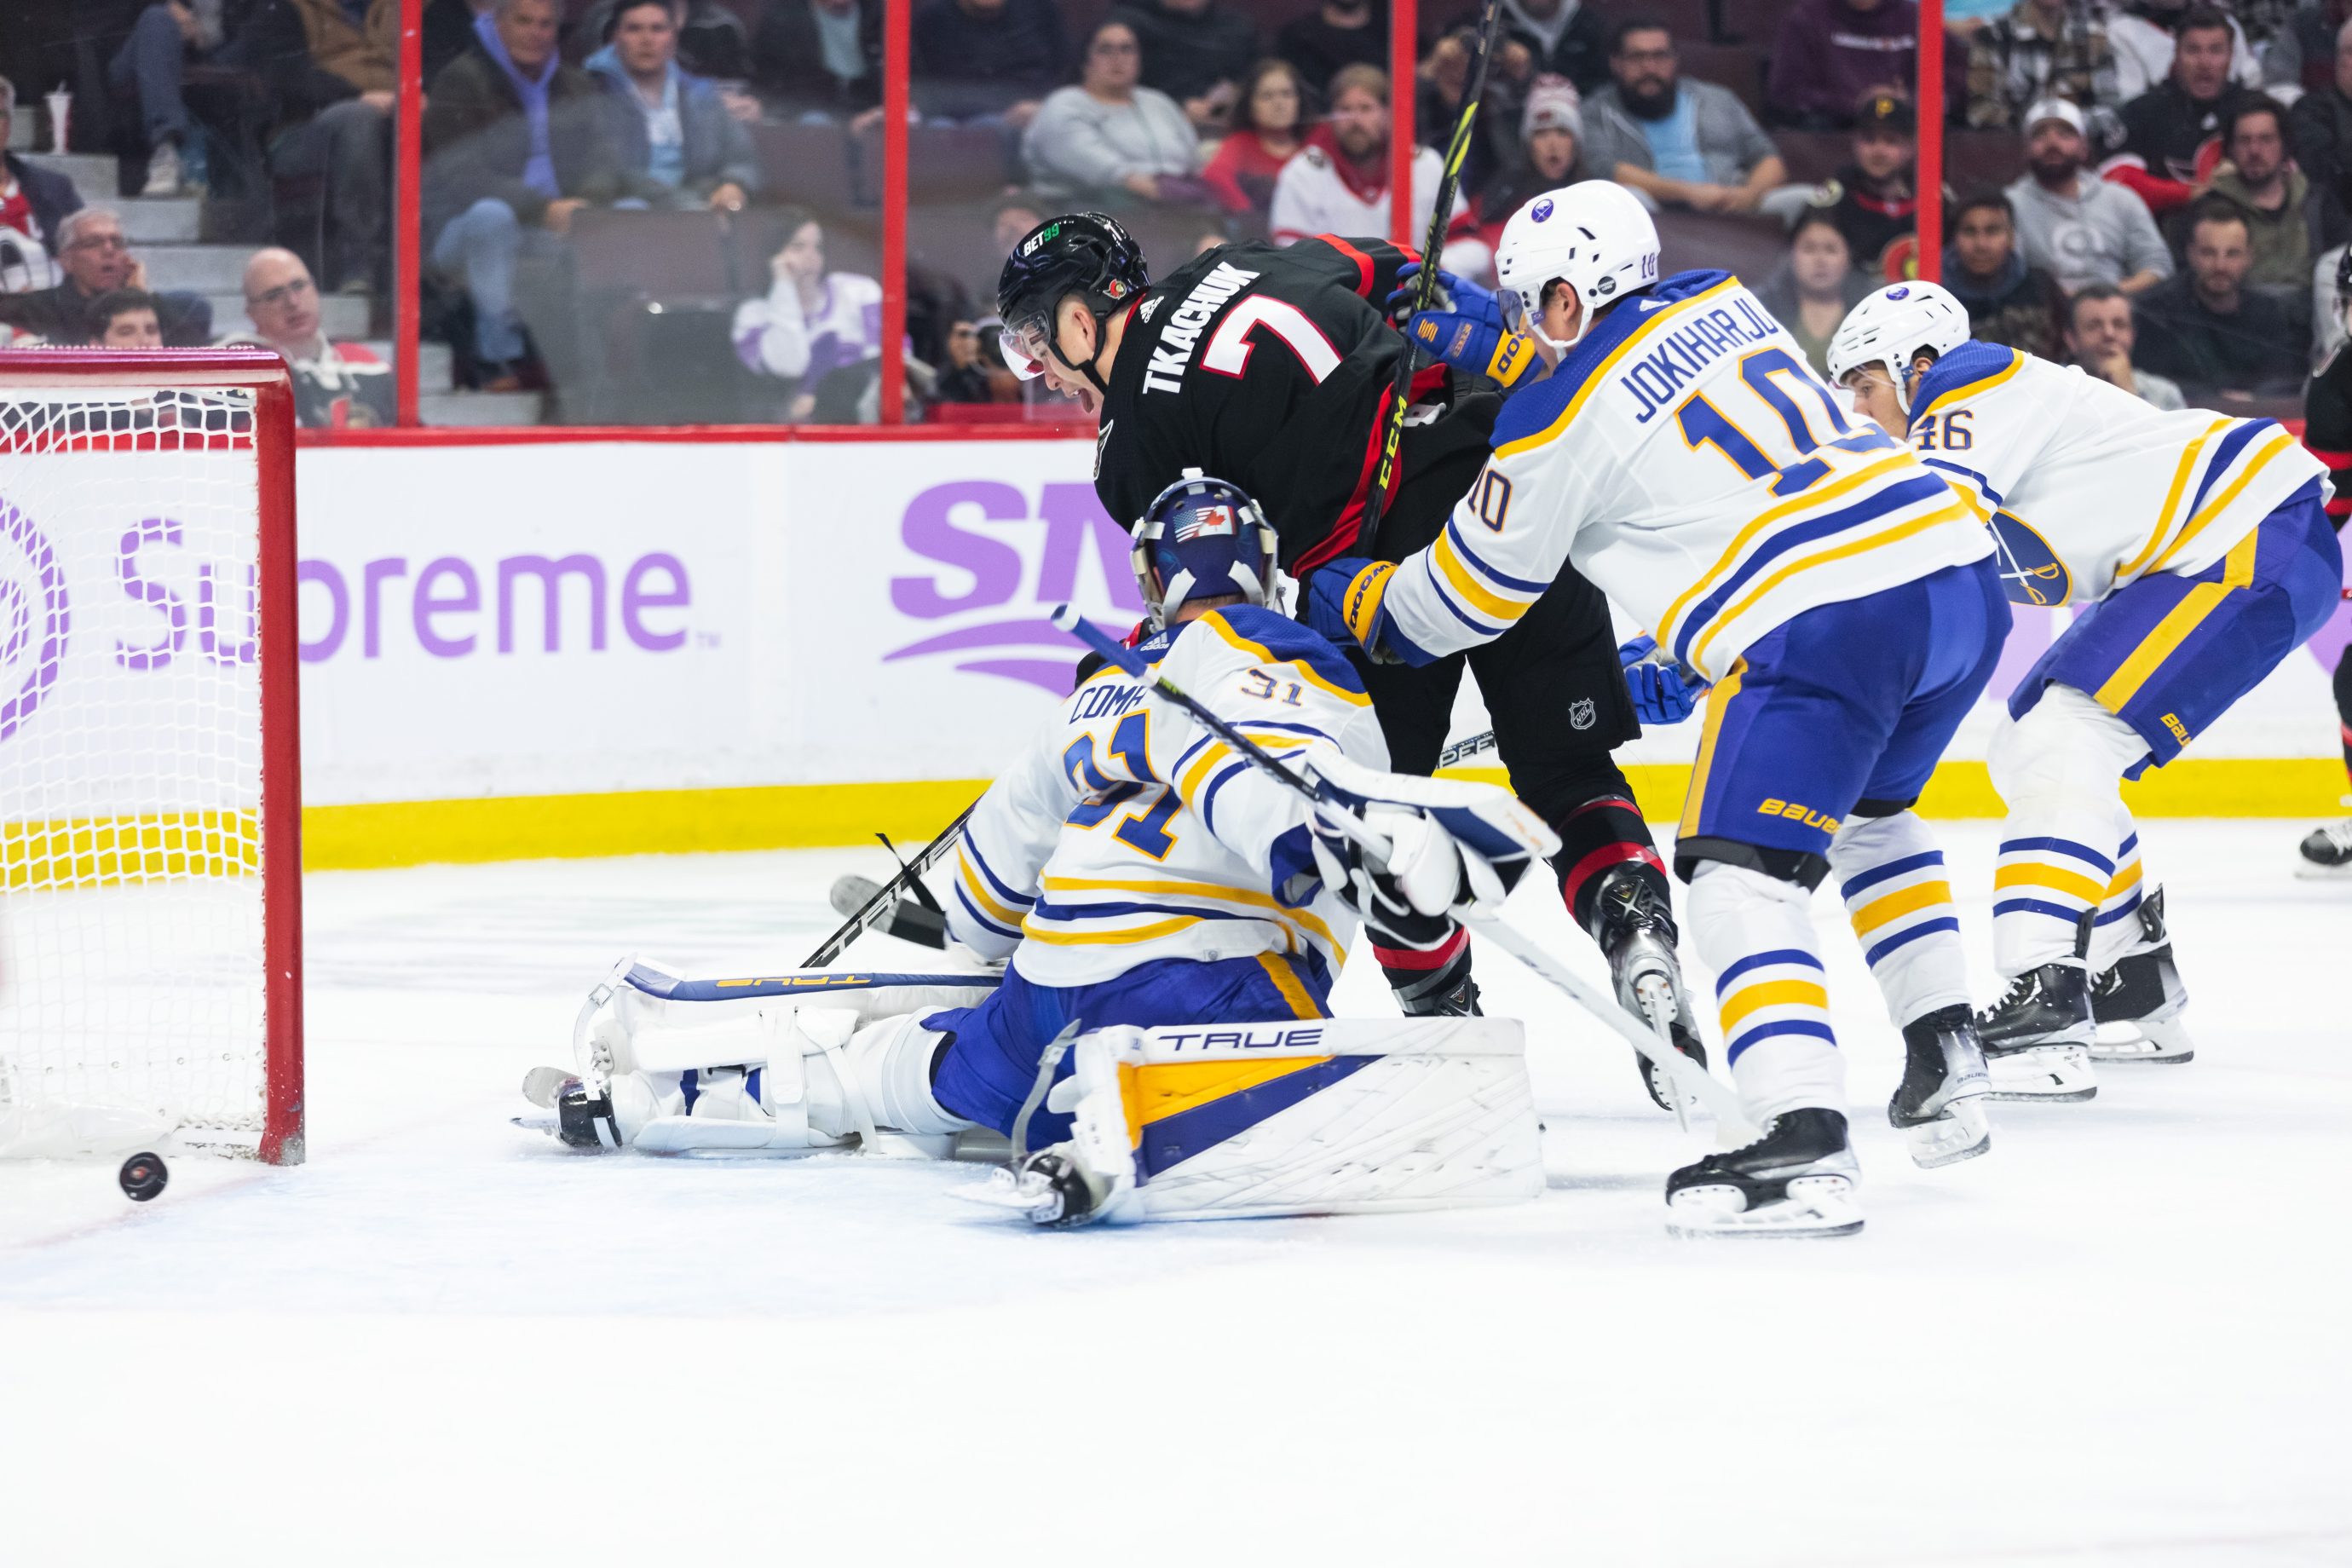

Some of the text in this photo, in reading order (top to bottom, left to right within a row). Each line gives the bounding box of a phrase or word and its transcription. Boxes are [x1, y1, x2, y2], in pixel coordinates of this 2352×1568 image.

[1024, 223, 1059, 257] BET99
[1641, 252, 1657, 279] 10
[1142, 261, 1260, 395] TKACHUK
[1199, 293, 1343, 387] 7
[1674, 345, 1897, 498] 10
[1908, 410, 1974, 451] 46
[1379, 395, 1408, 491] CCM
[1467, 465, 1513, 533] 10
[1241, 667, 1302, 706] 31
[2159, 712, 2192, 747] Bau
[1063, 730, 1179, 862] 31
[1757, 798, 1841, 835] Baue
[821, 824, 961, 962] TRUE
[715, 975, 873, 988] TRUE
[1158, 1028, 1323, 1052] TRUE
